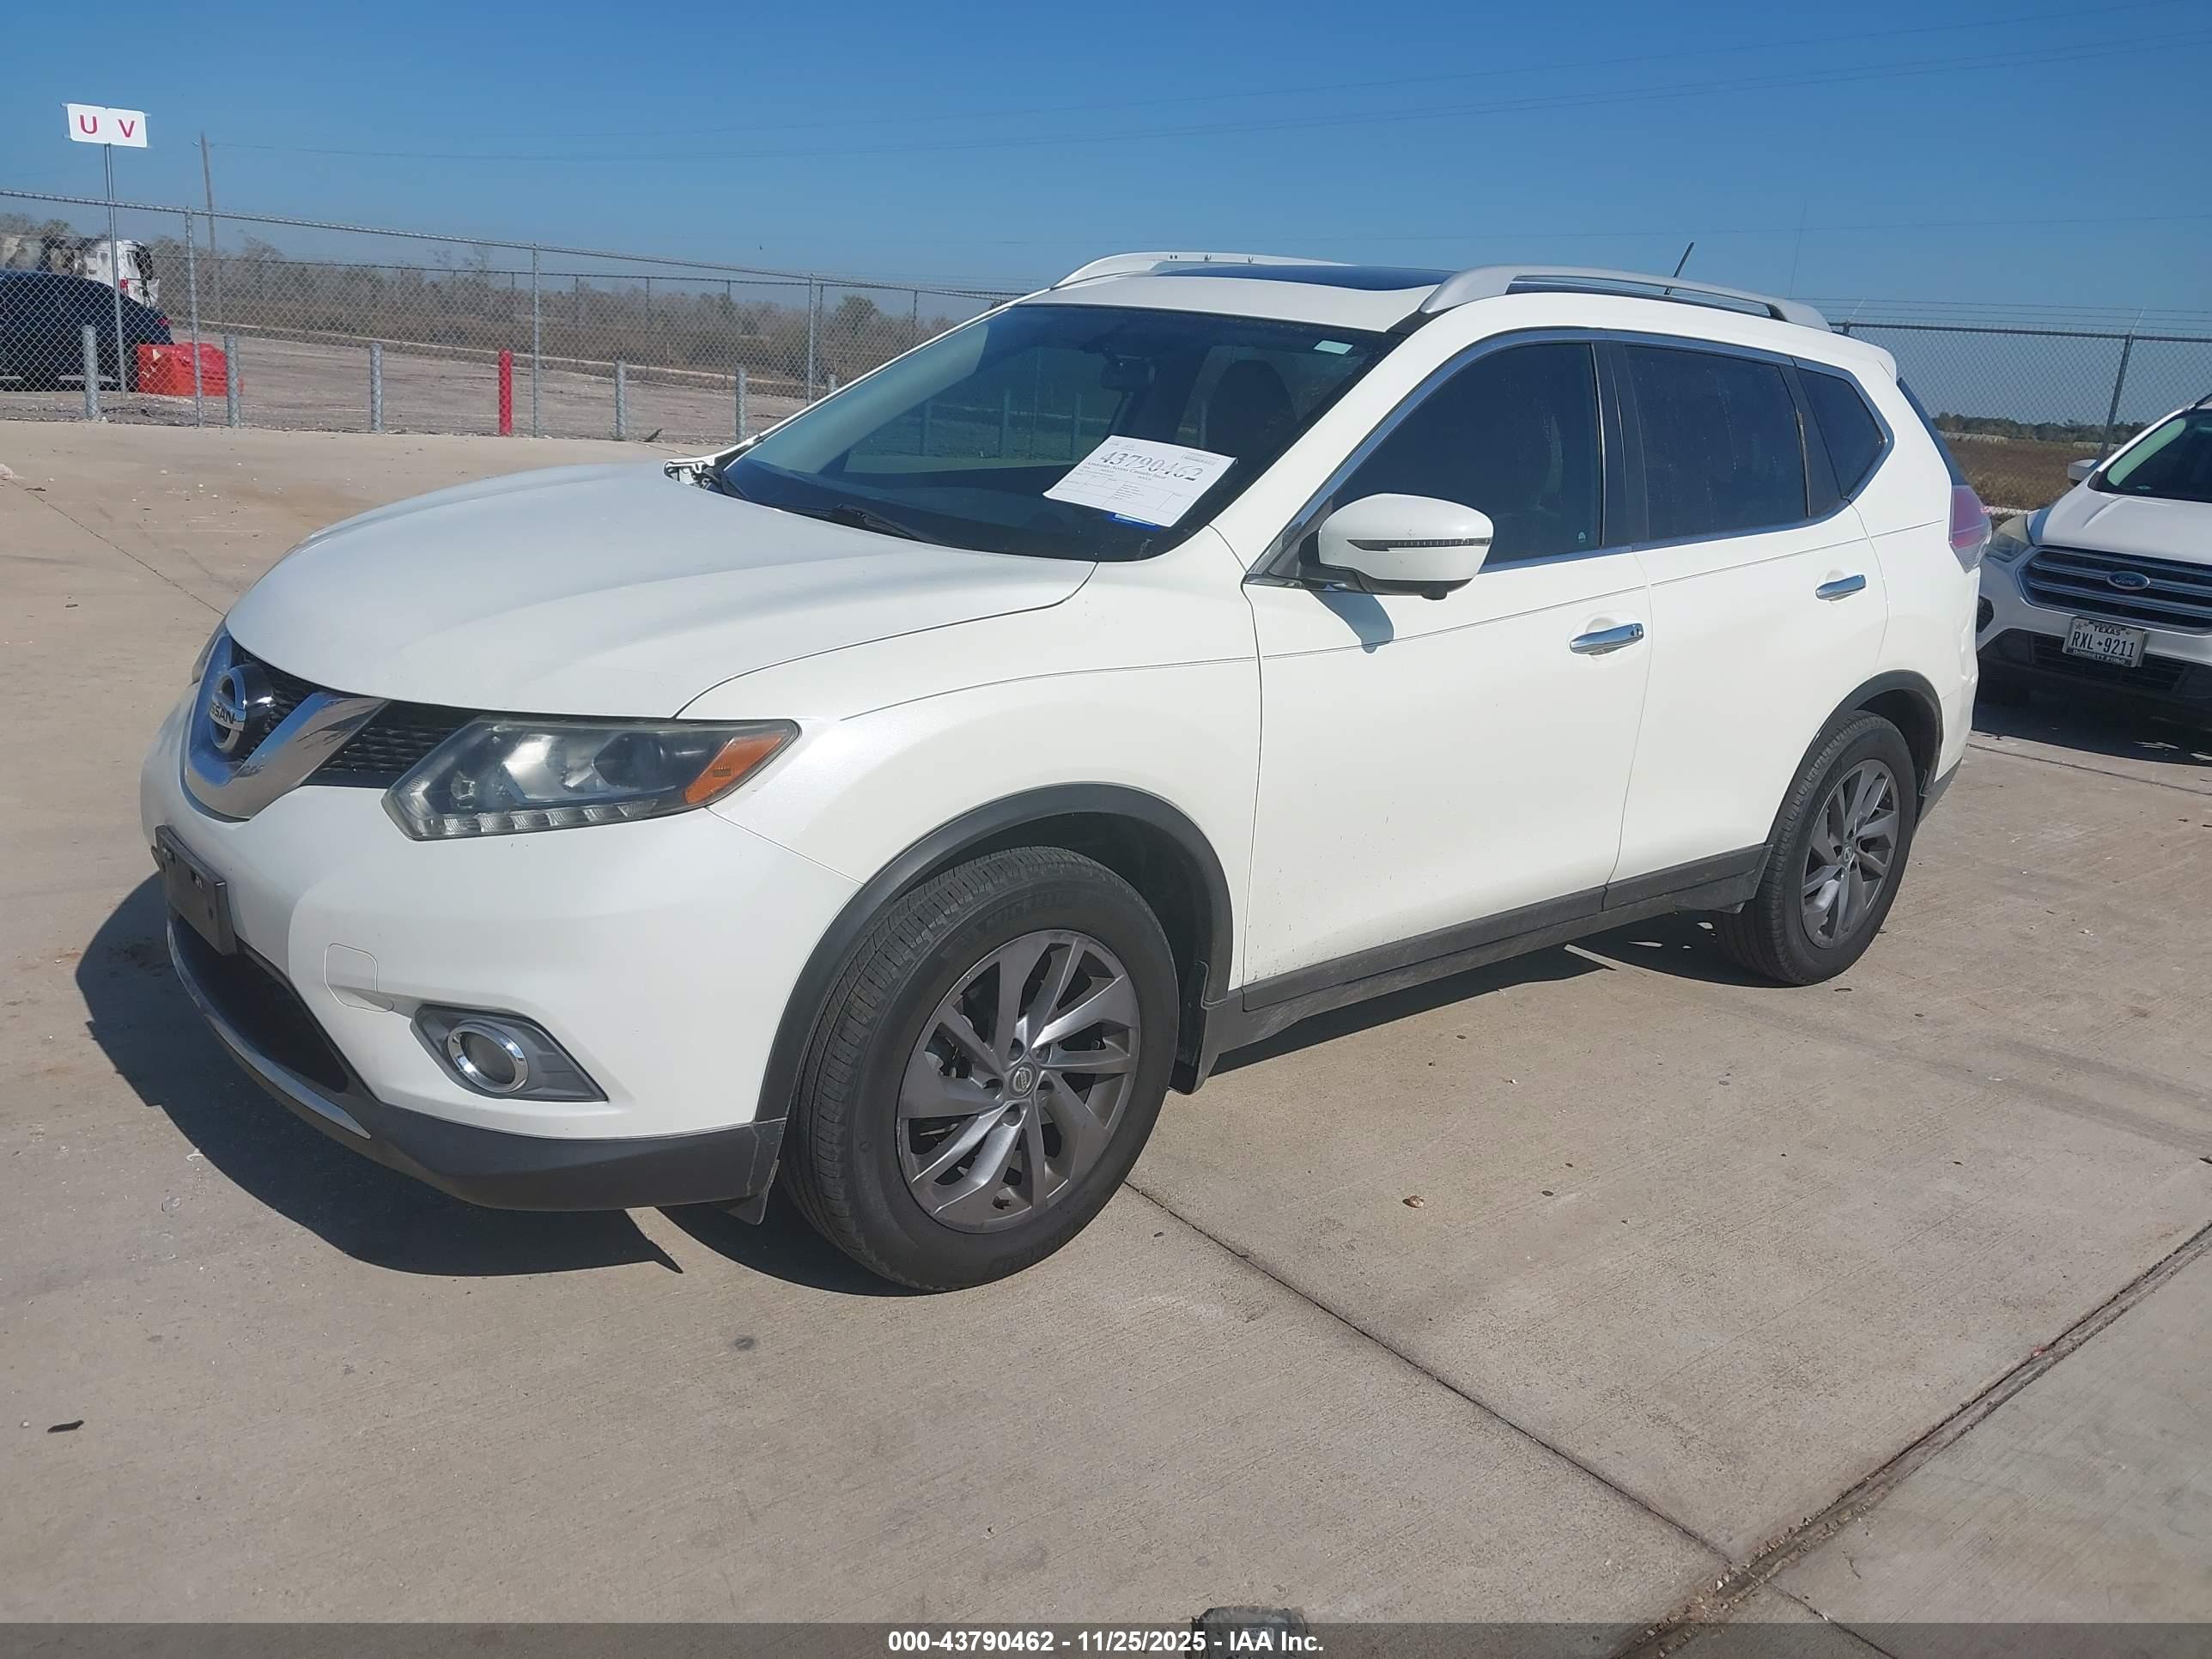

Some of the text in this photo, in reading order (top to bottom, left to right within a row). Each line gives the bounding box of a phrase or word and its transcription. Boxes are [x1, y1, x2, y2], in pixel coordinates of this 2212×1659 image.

[80, 114, 135, 137] U V
[1100, 451, 1203, 482] 43790462
[2116, 576, 2136, 585] Ford
[2094, 625, 2121, 635] TEXAS
[2072, 631, 2135, 658] RXL 9211
